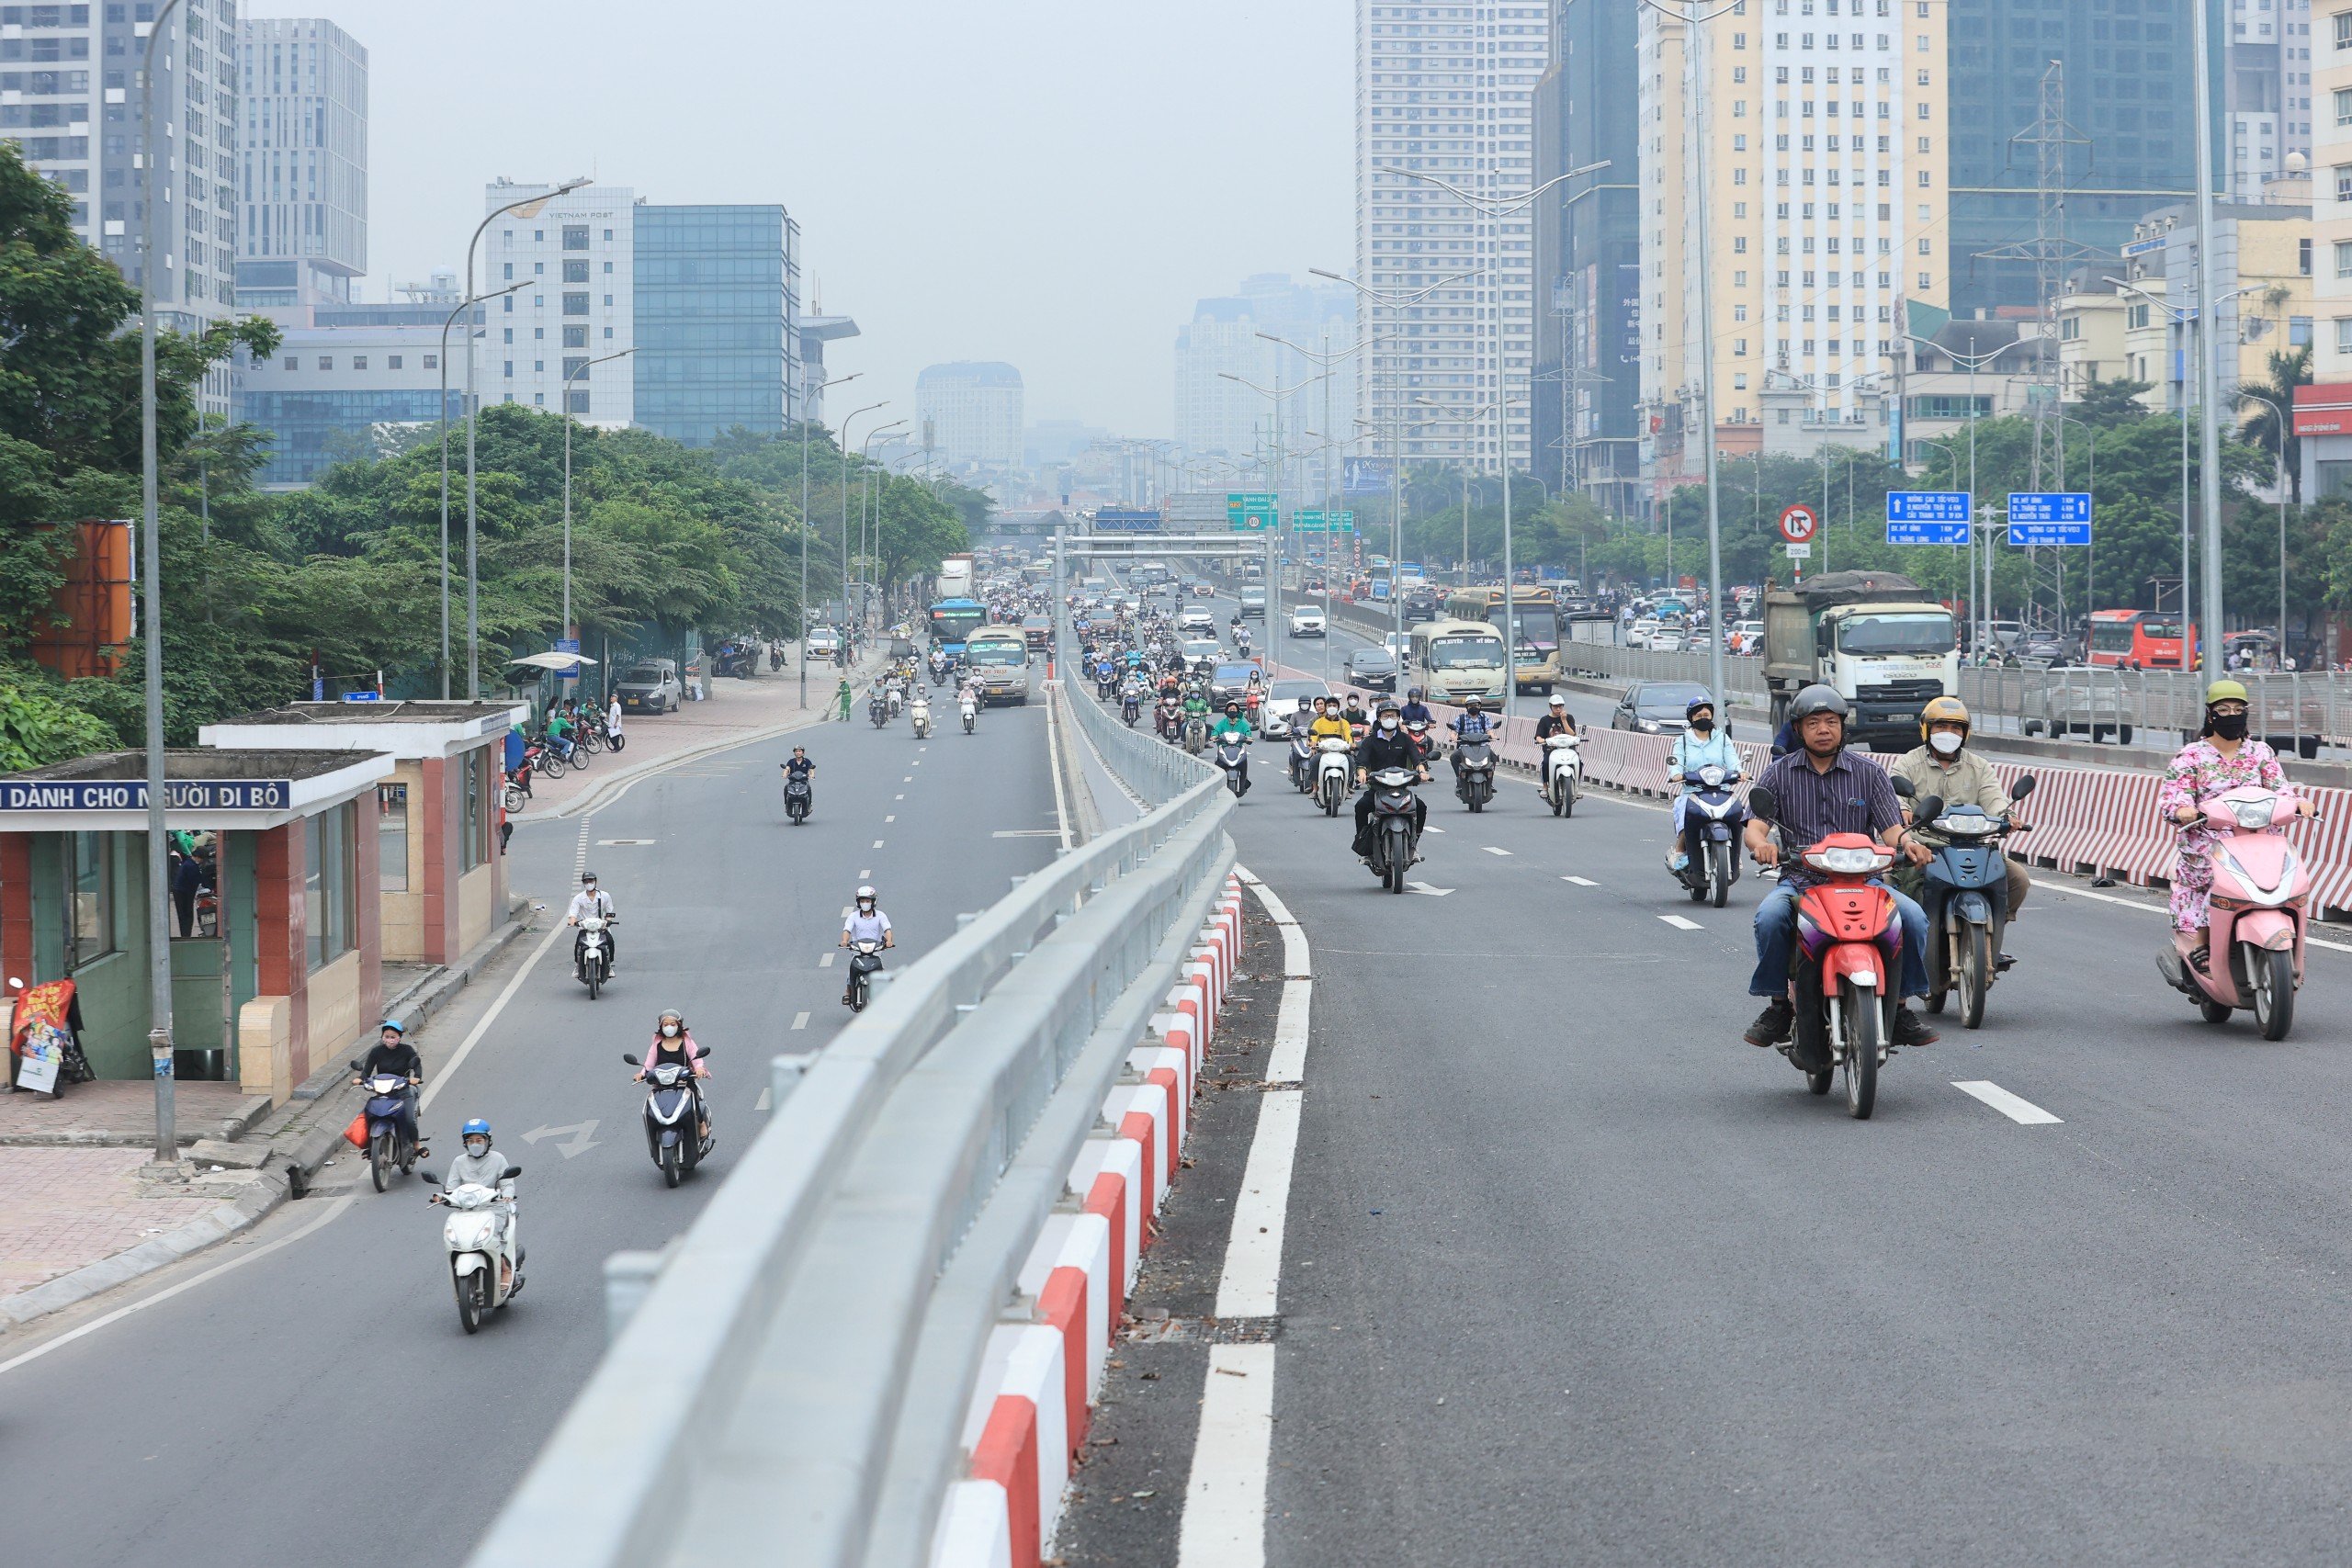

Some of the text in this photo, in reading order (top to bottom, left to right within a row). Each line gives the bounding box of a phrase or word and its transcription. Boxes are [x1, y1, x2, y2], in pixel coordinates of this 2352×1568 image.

[10, 784, 74, 807] DÀNH
[83, 787, 129, 807] CHO
[220, 787, 241, 807] ĐI
